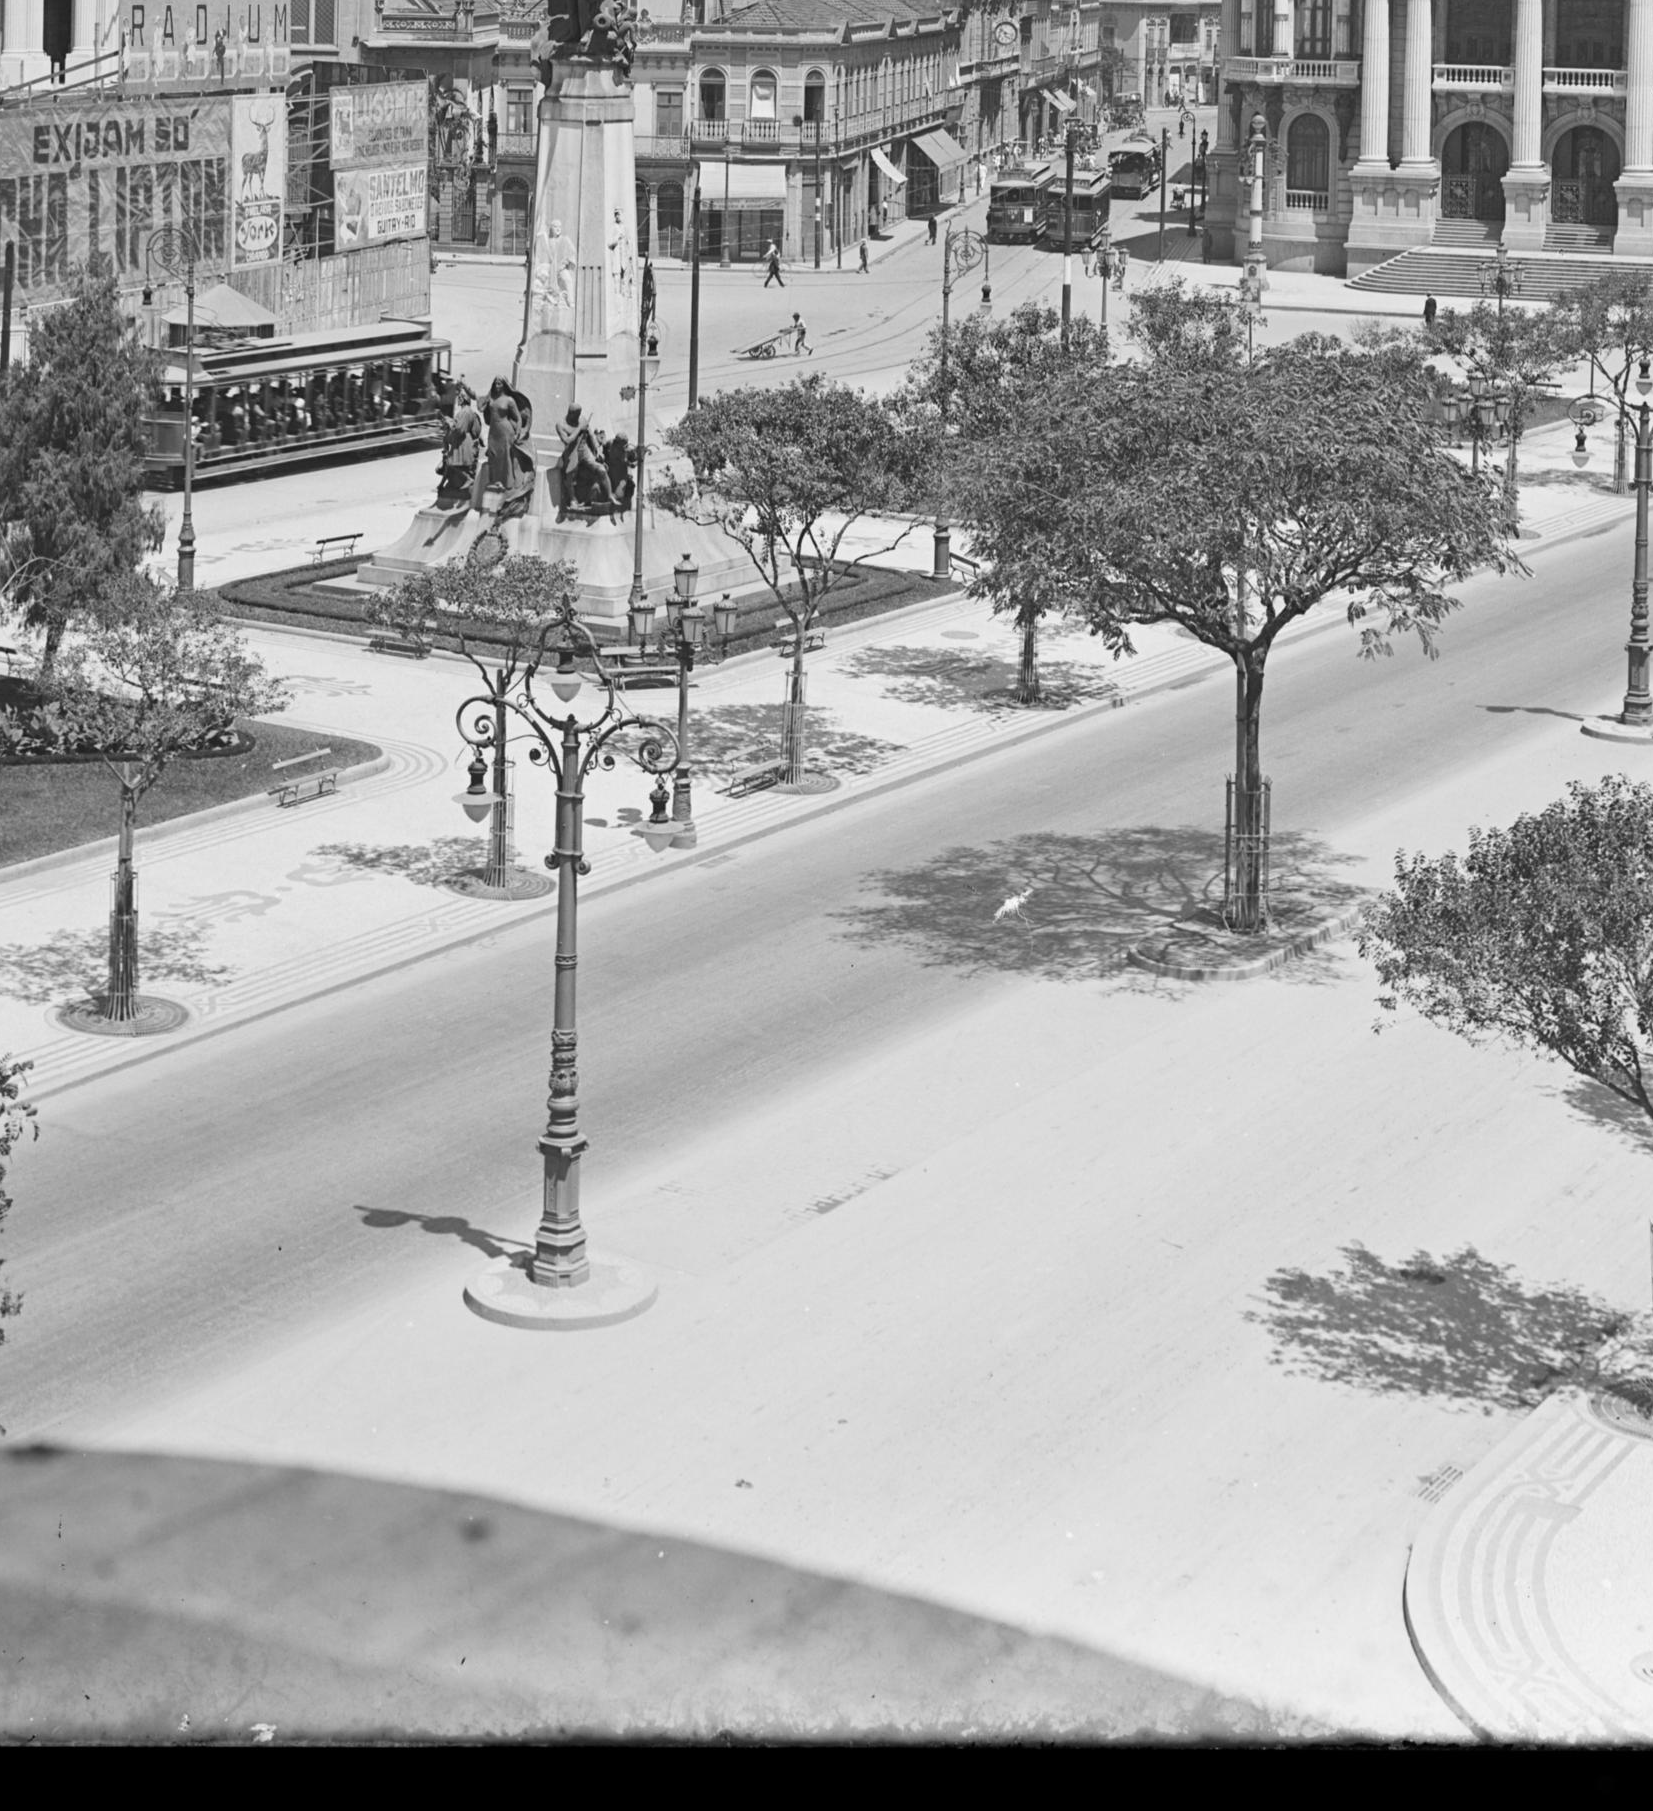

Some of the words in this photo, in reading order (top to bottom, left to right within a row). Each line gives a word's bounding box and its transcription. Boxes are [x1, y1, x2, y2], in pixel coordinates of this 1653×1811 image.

[131, 4, 287, 47] RADIUM
[33, 117, 145, 164] EXIJAM
[240, 220, 274, 244] York
